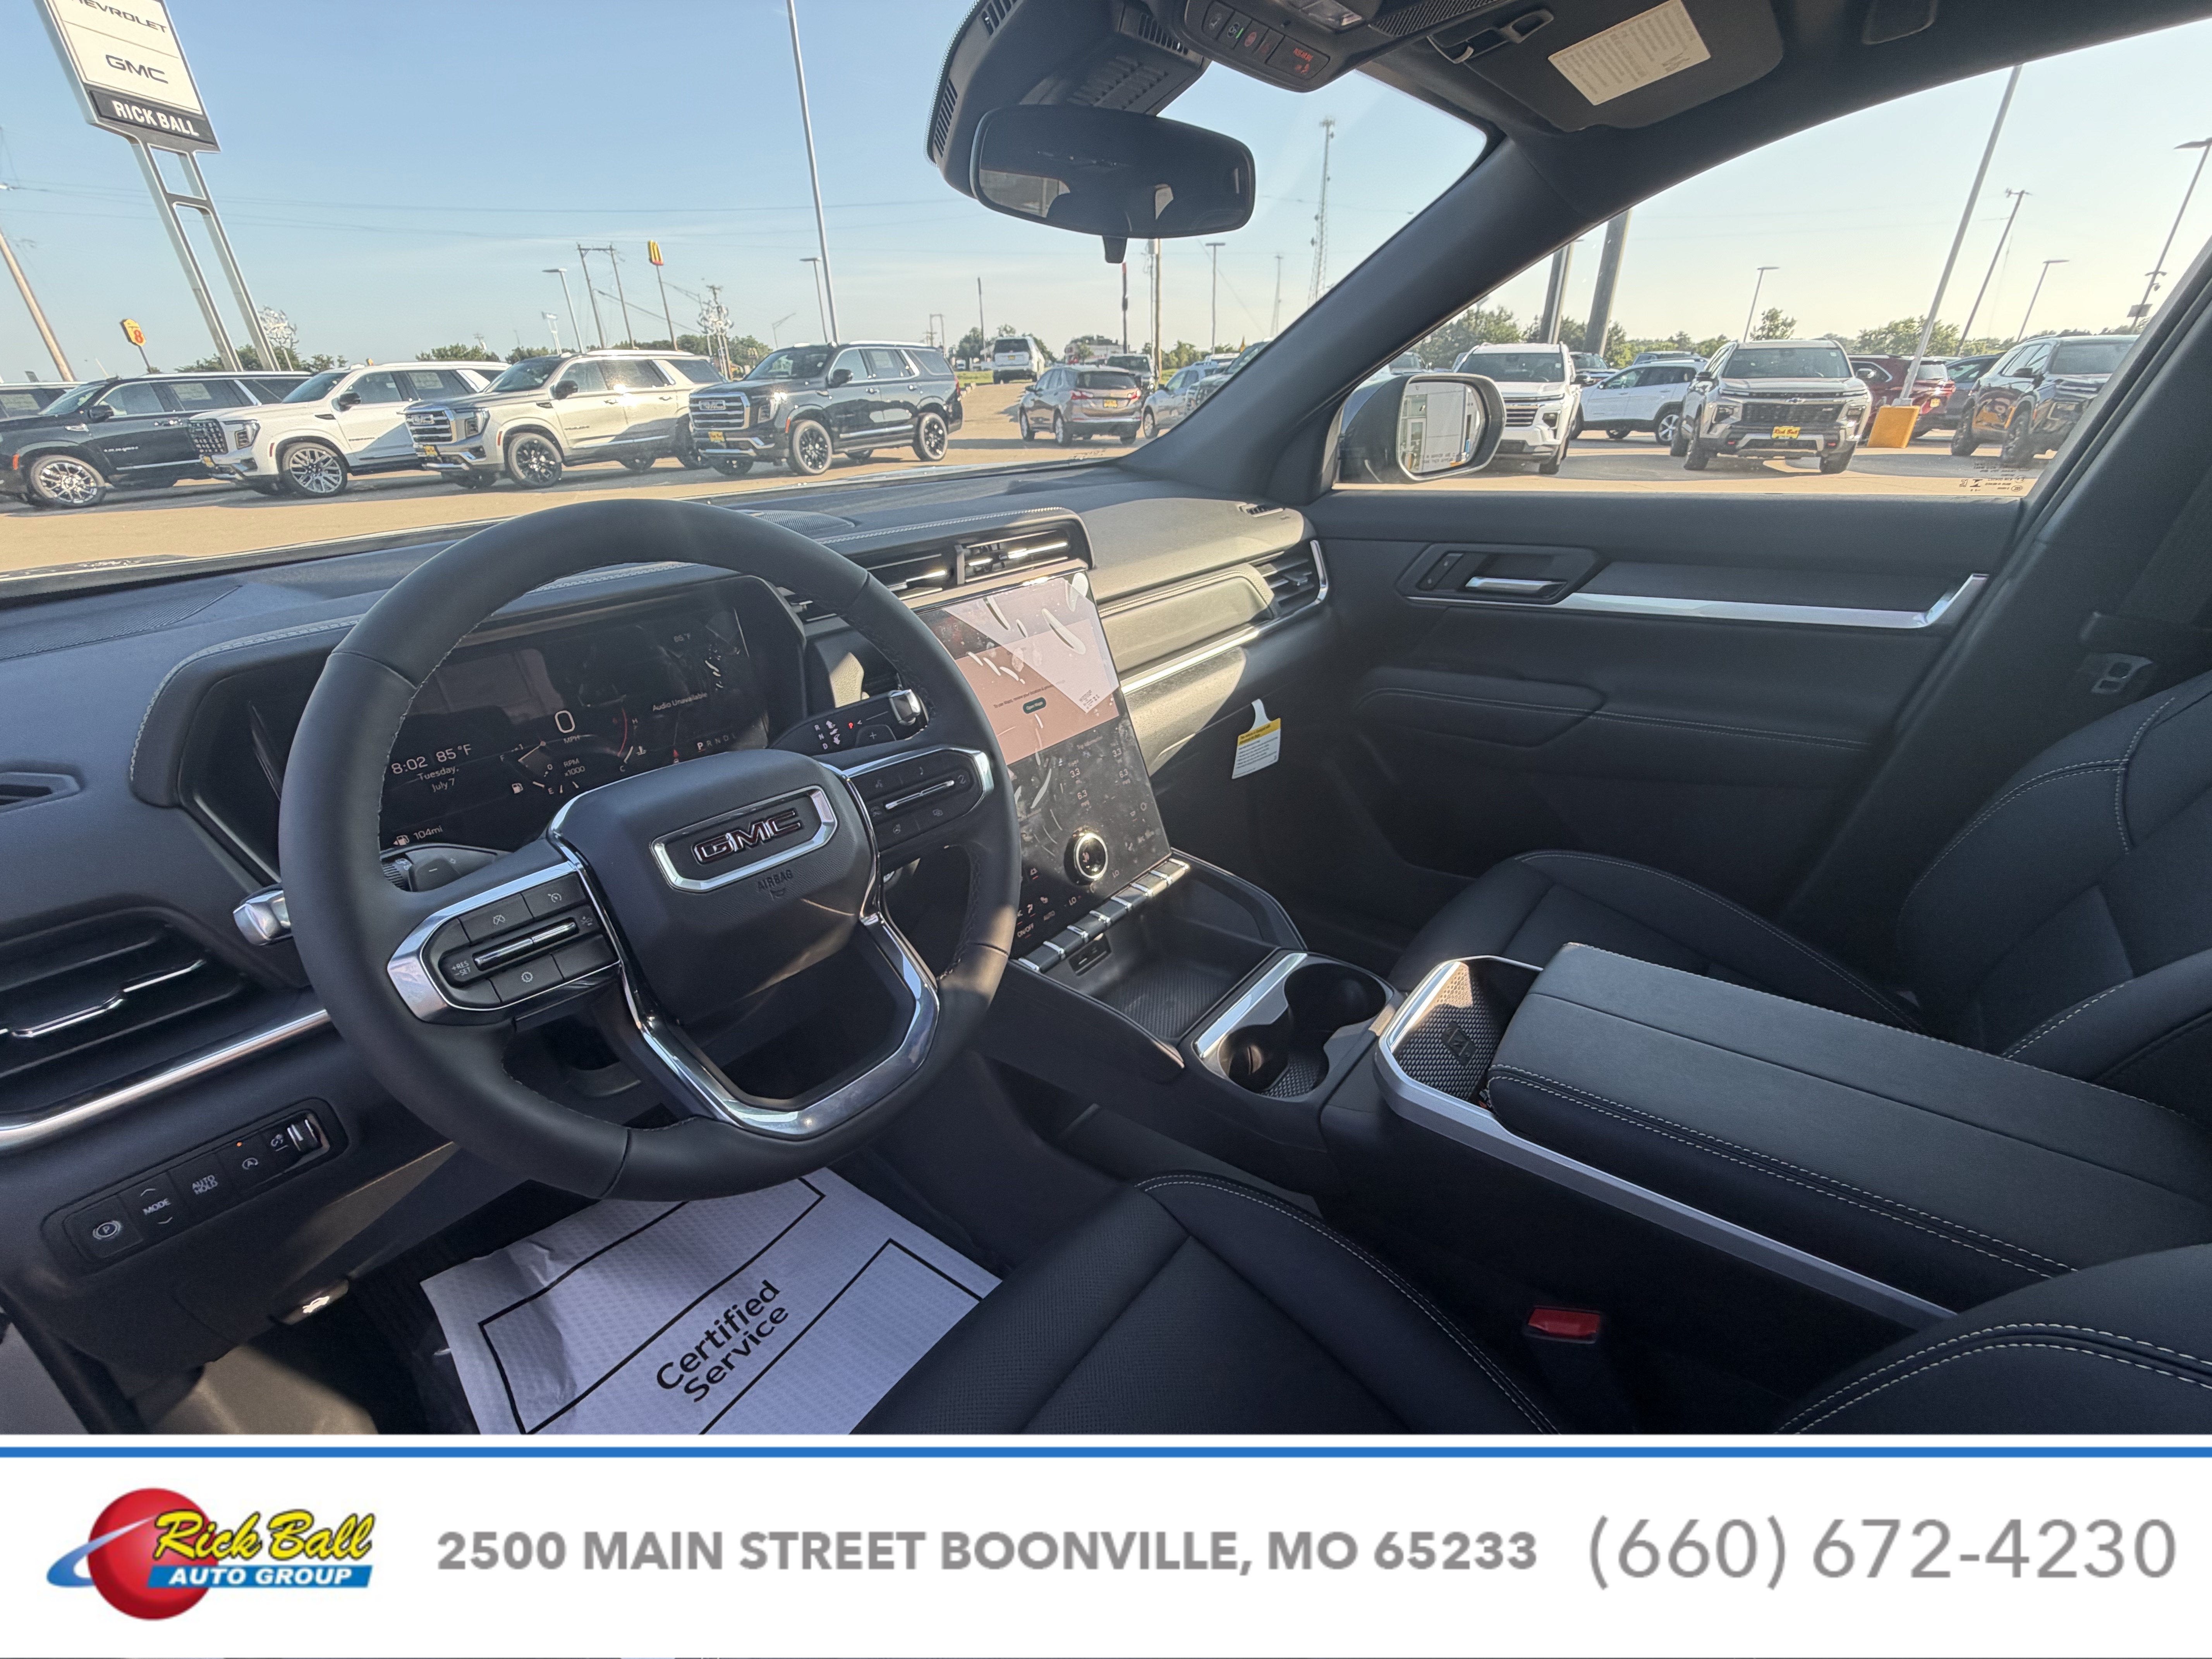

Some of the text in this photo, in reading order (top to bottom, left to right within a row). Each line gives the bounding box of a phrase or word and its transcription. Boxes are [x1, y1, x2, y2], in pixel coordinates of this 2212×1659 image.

[71, 0, 167, 33] EVROLET
[105, 54, 168, 84] GMC
[112, 100, 200, 136] RICK BALL
[134, 329, 144, 343] 8
[652, 692, 708, 712] Audio Unavailable
[555, 710, 575, 733] 0
[563, 735, 580, 744] MPH
[697, 742, 703, 750] P
[391, 756, 428, 775] 8:02
[563, 758, 580, 768] RPM
[564, 766, 586, 776] x1000
[431, 778, 455, 793] July 7
[693, 809, 801, 864] GMC
[757, 869, 793, 891] AIRBAG
[192, 1175, 216, 1189] AUTO
[194, 1180, 218, 1195] HOLD
[142, 1198, 172, 1216] MODE
[656, 1279, 781, 1389] Certified
[684, 1307, 789, 1403] Service
